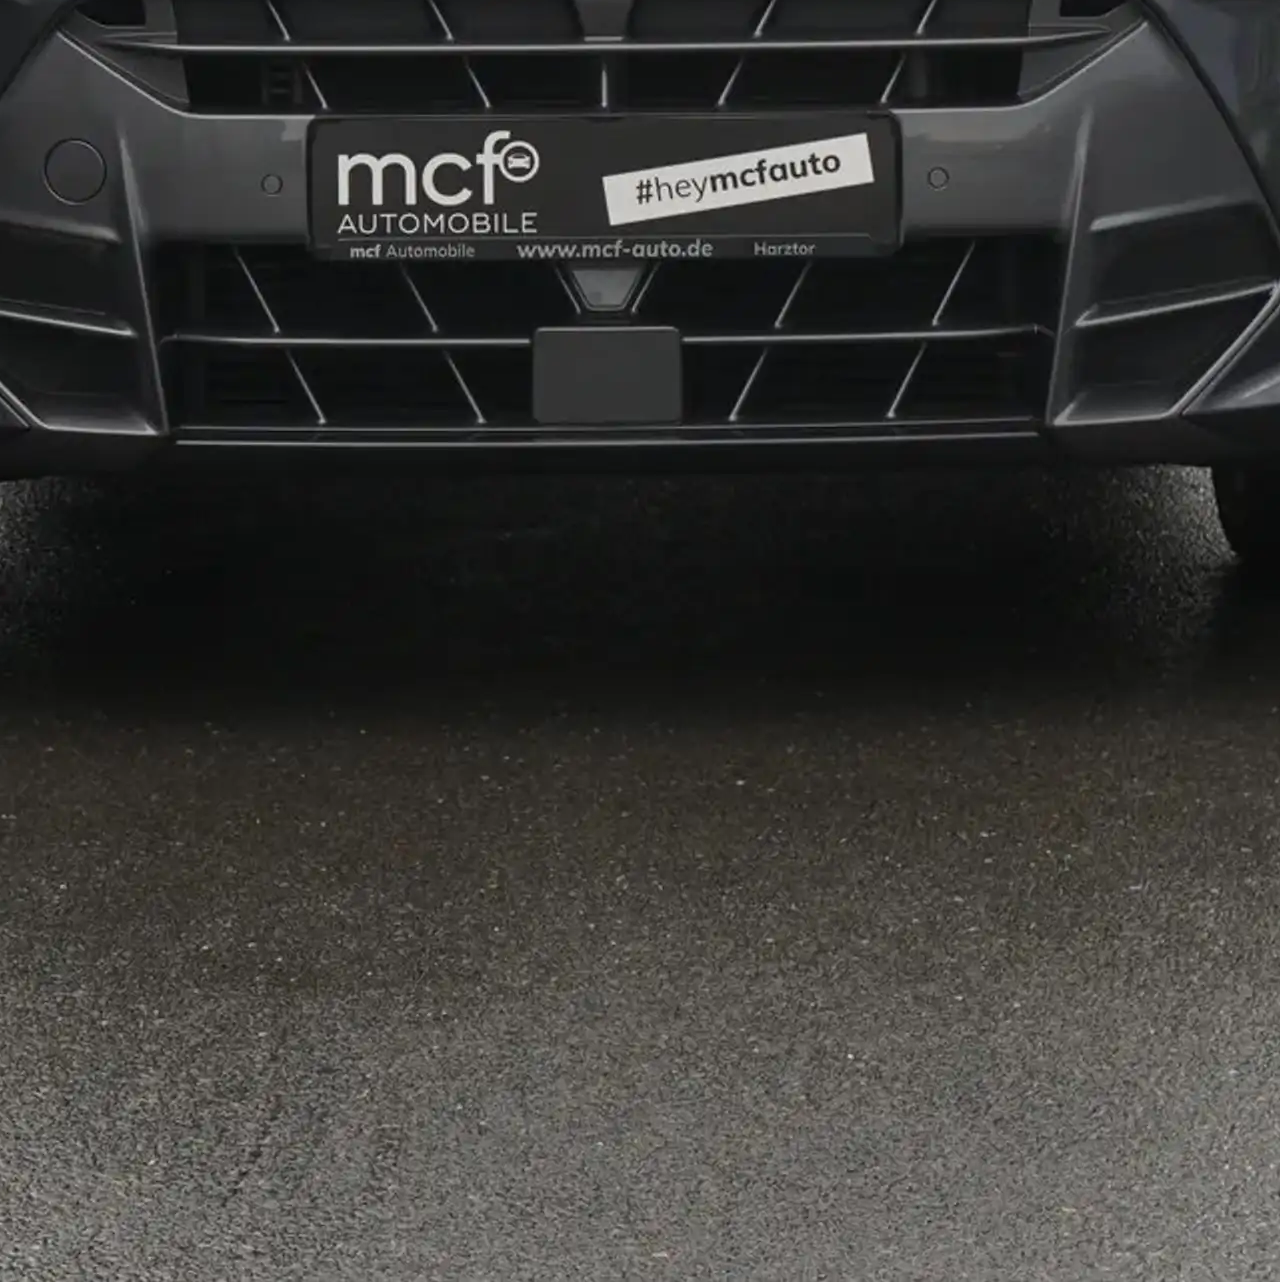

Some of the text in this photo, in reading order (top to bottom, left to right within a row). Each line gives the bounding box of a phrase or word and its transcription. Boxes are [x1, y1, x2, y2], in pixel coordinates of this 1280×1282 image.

[337, 130, 512, 206] mcf
[635, 153, 841, 204] #heymcfauto
[337, 212, 538, 234] AUTOMOBILE
[350, 239, 816, 259] mcf Automobile www.mcf-auto.de Harztor
